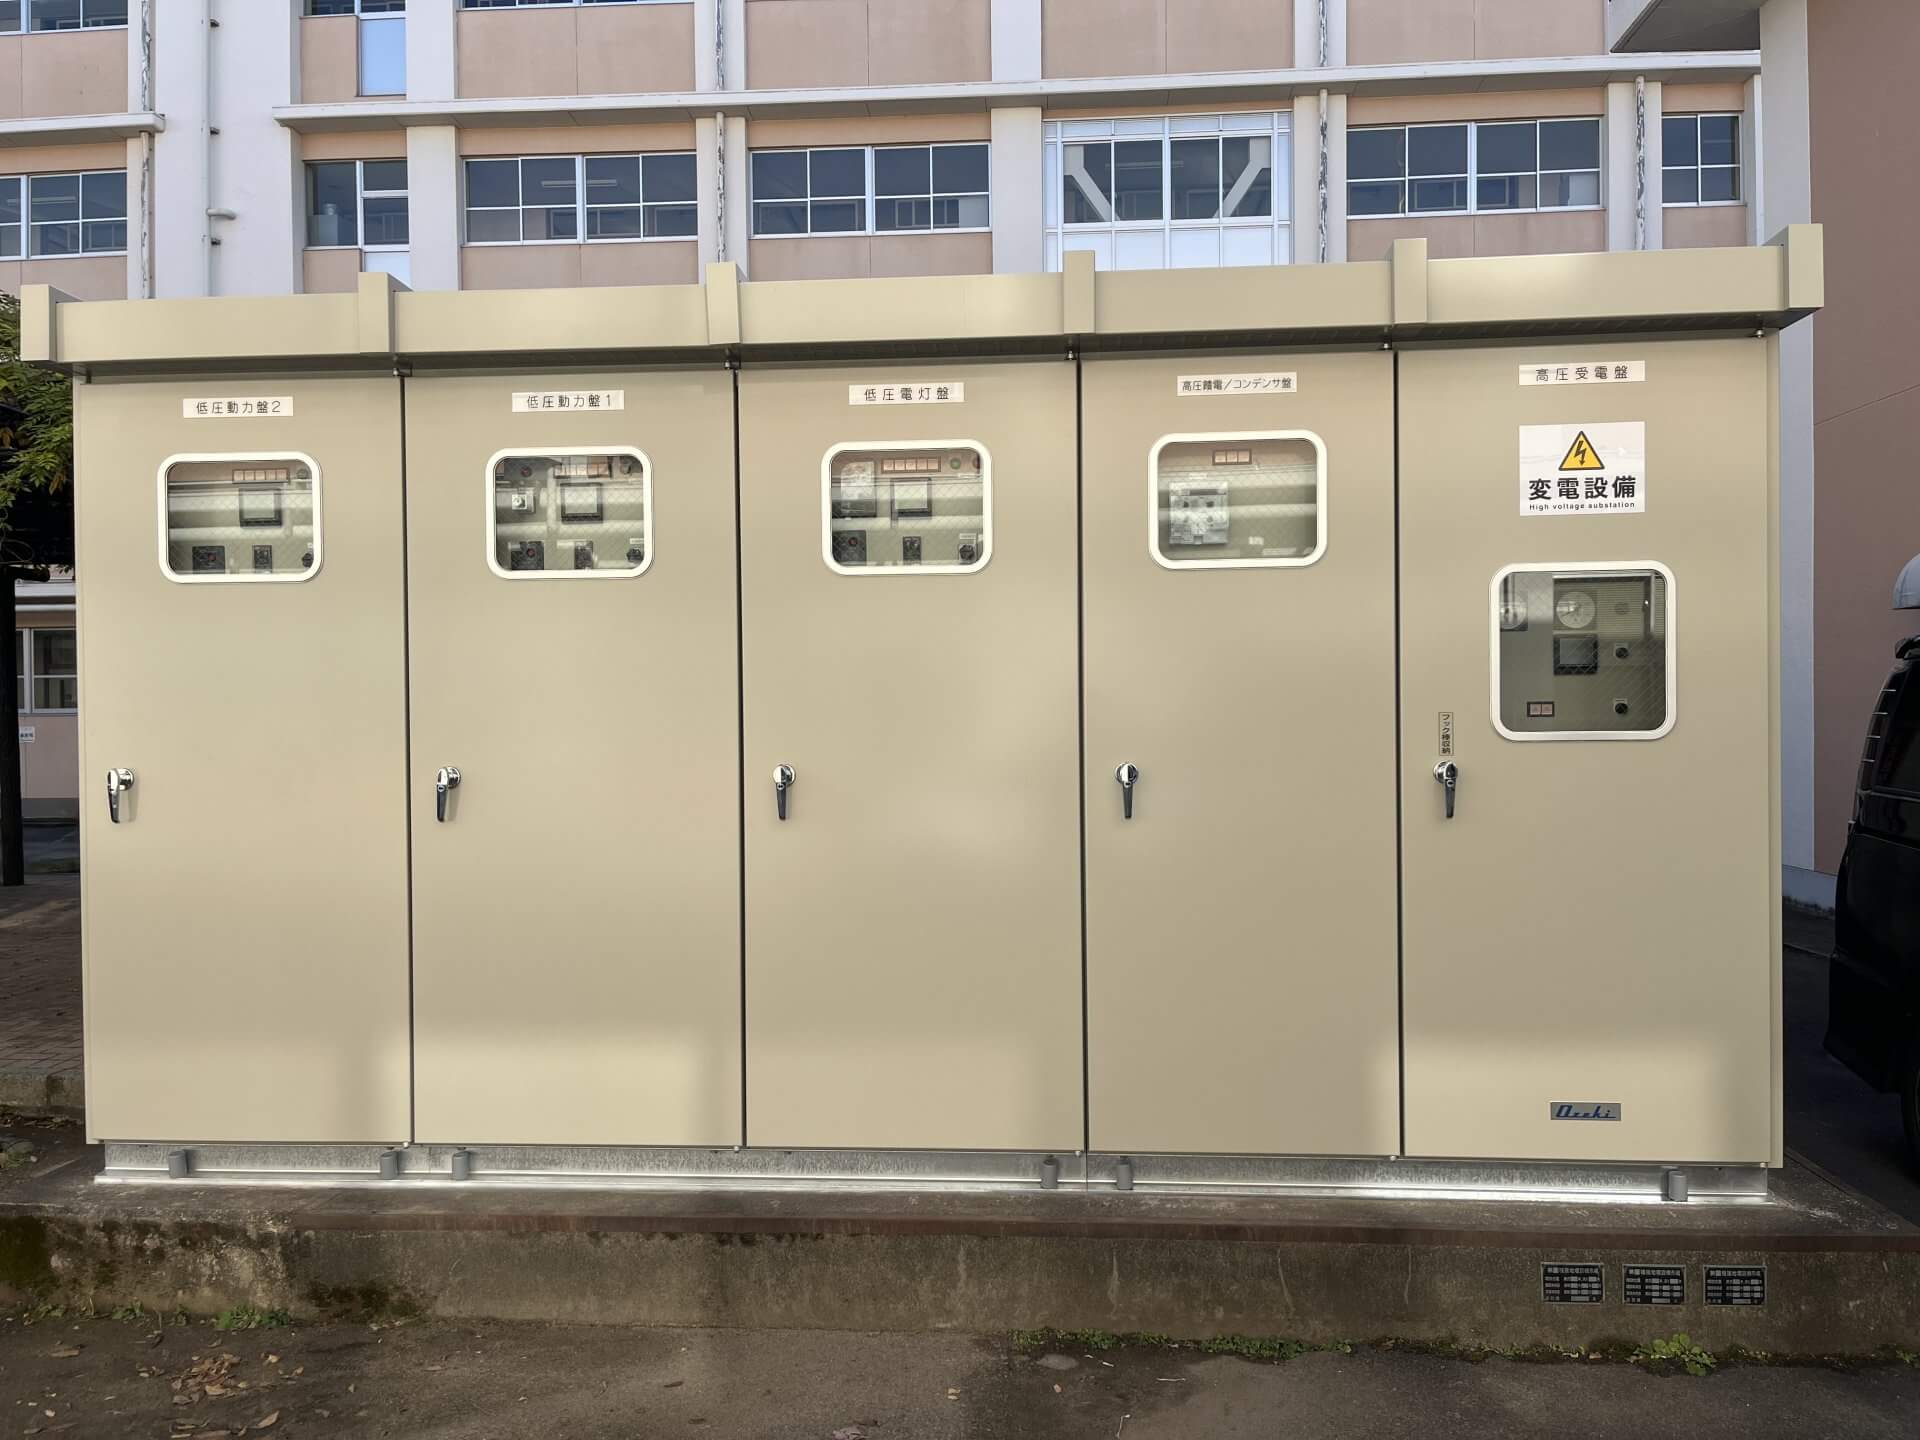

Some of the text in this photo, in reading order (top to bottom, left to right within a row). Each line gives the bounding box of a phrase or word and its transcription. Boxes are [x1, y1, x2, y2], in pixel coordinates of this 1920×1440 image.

[1535, 365, 1628, 382] 高圧受電盤
[527, 393, 611, 409] 低圧動力盤1
[864, 386, 949, 402] 低圧電灯盤
[196, 400, 281, 415] 低圧動力盤2
[1528, 475, 1637, 501] 変電設備
[1529, 501, 1635, 511] High voltage substation
